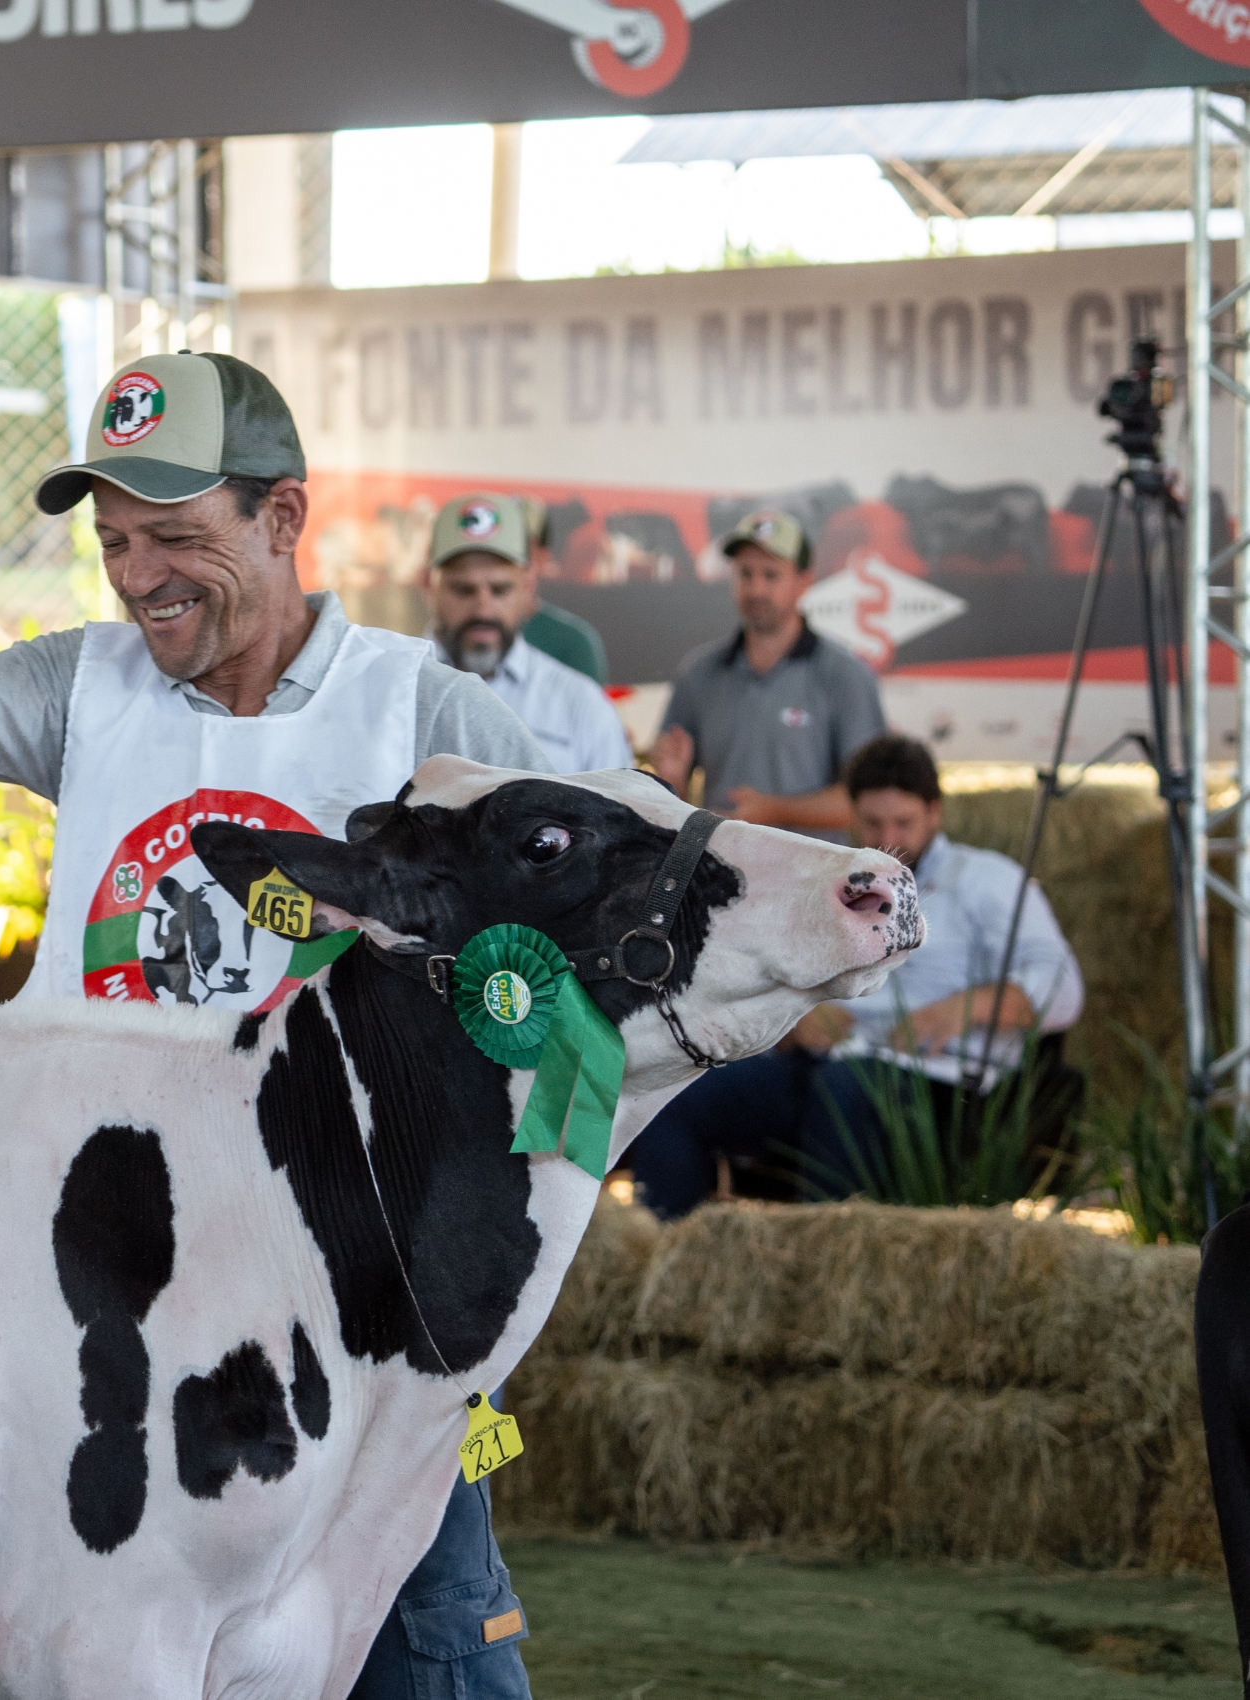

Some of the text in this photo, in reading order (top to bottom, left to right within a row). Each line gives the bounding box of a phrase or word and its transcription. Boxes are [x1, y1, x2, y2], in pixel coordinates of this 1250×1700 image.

[317, 318, 537, 431] FONTE
[566, 314, 664, 425] DA
[699, 294, 1033, 424] MELHOR
[251, 892, 305, 936] 465
[491, 980, 501, 1010] Expo
[499, 979, 512, 1018] Agro
[460, 1417, 512, 1453] COTRICAMPO
[469, 1428, 511, 1477] 21
